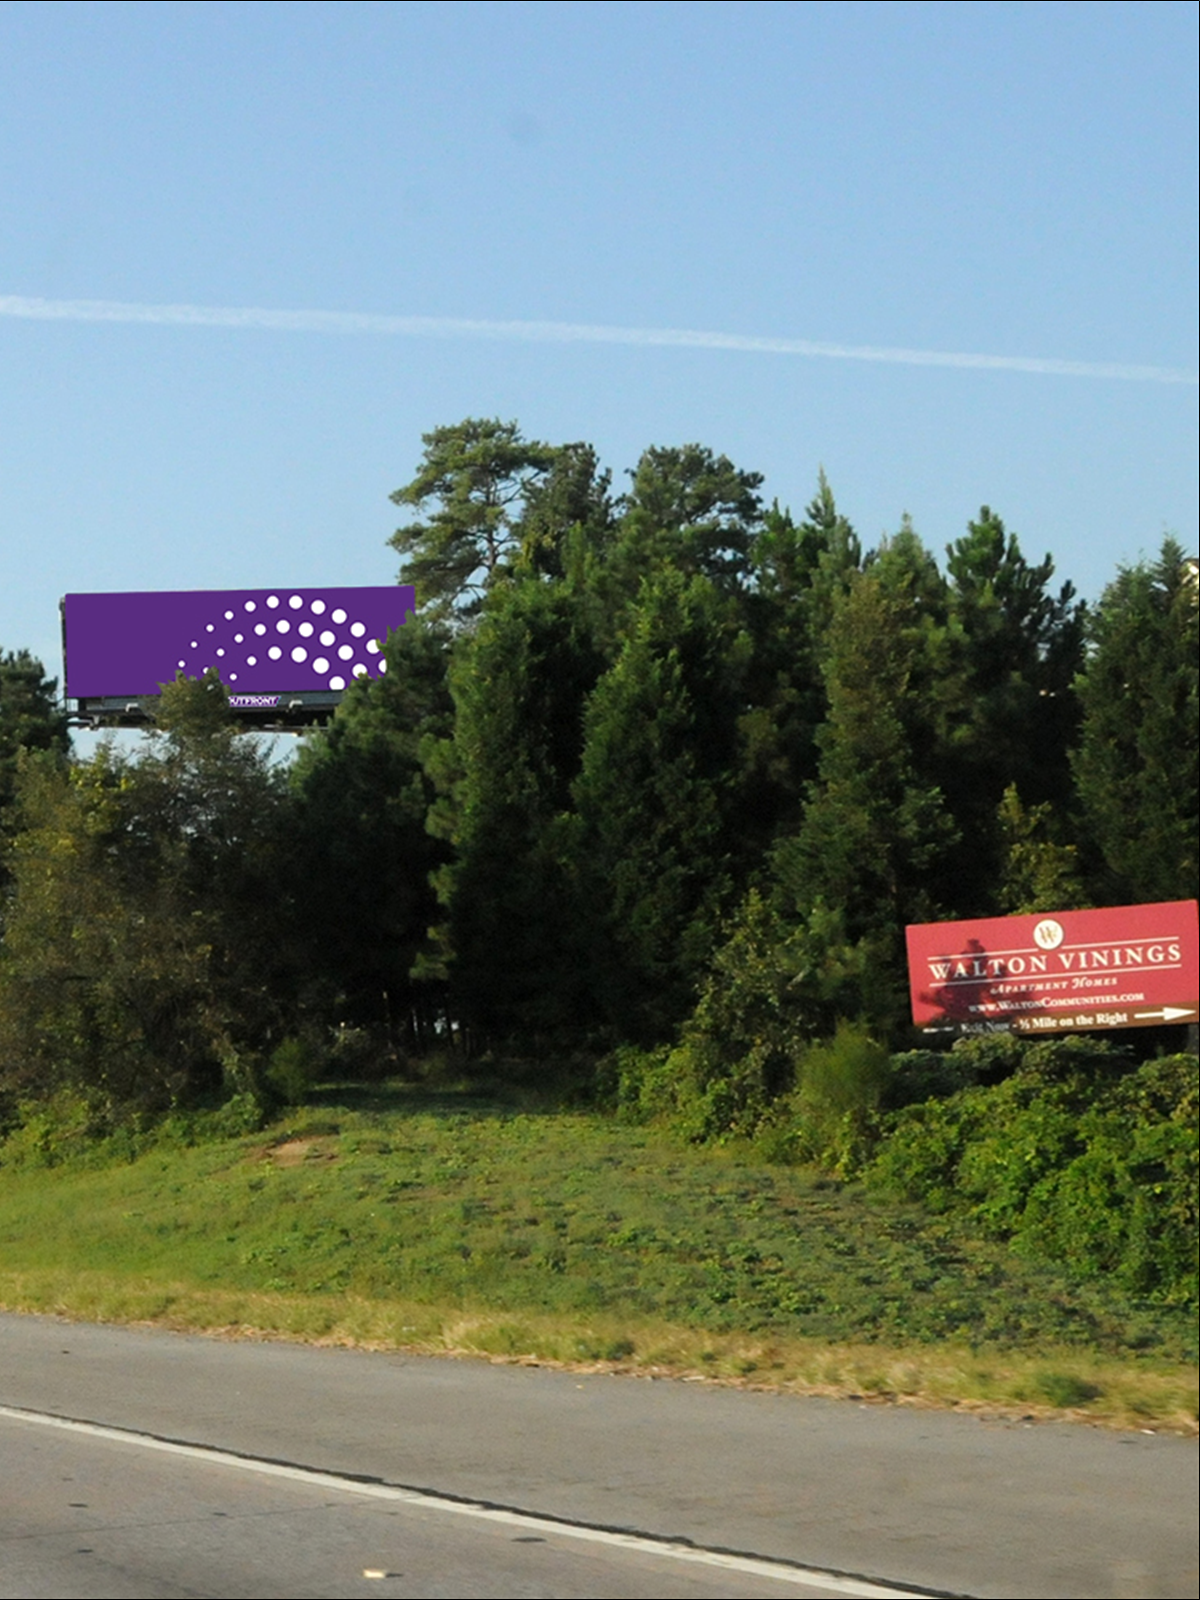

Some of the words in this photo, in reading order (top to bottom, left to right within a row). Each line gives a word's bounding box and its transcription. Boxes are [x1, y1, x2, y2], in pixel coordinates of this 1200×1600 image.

[928, 955, 1047, 980] WALTON
[1058, 944, 1181, 969] VININGS
[1032, 1016, 1058, 1029] Mile
[1059, 1017, 1075, 1027] on
[1076, 1014, 1094, 1026] the
[1096, 1012, 1128, 1026] Right
